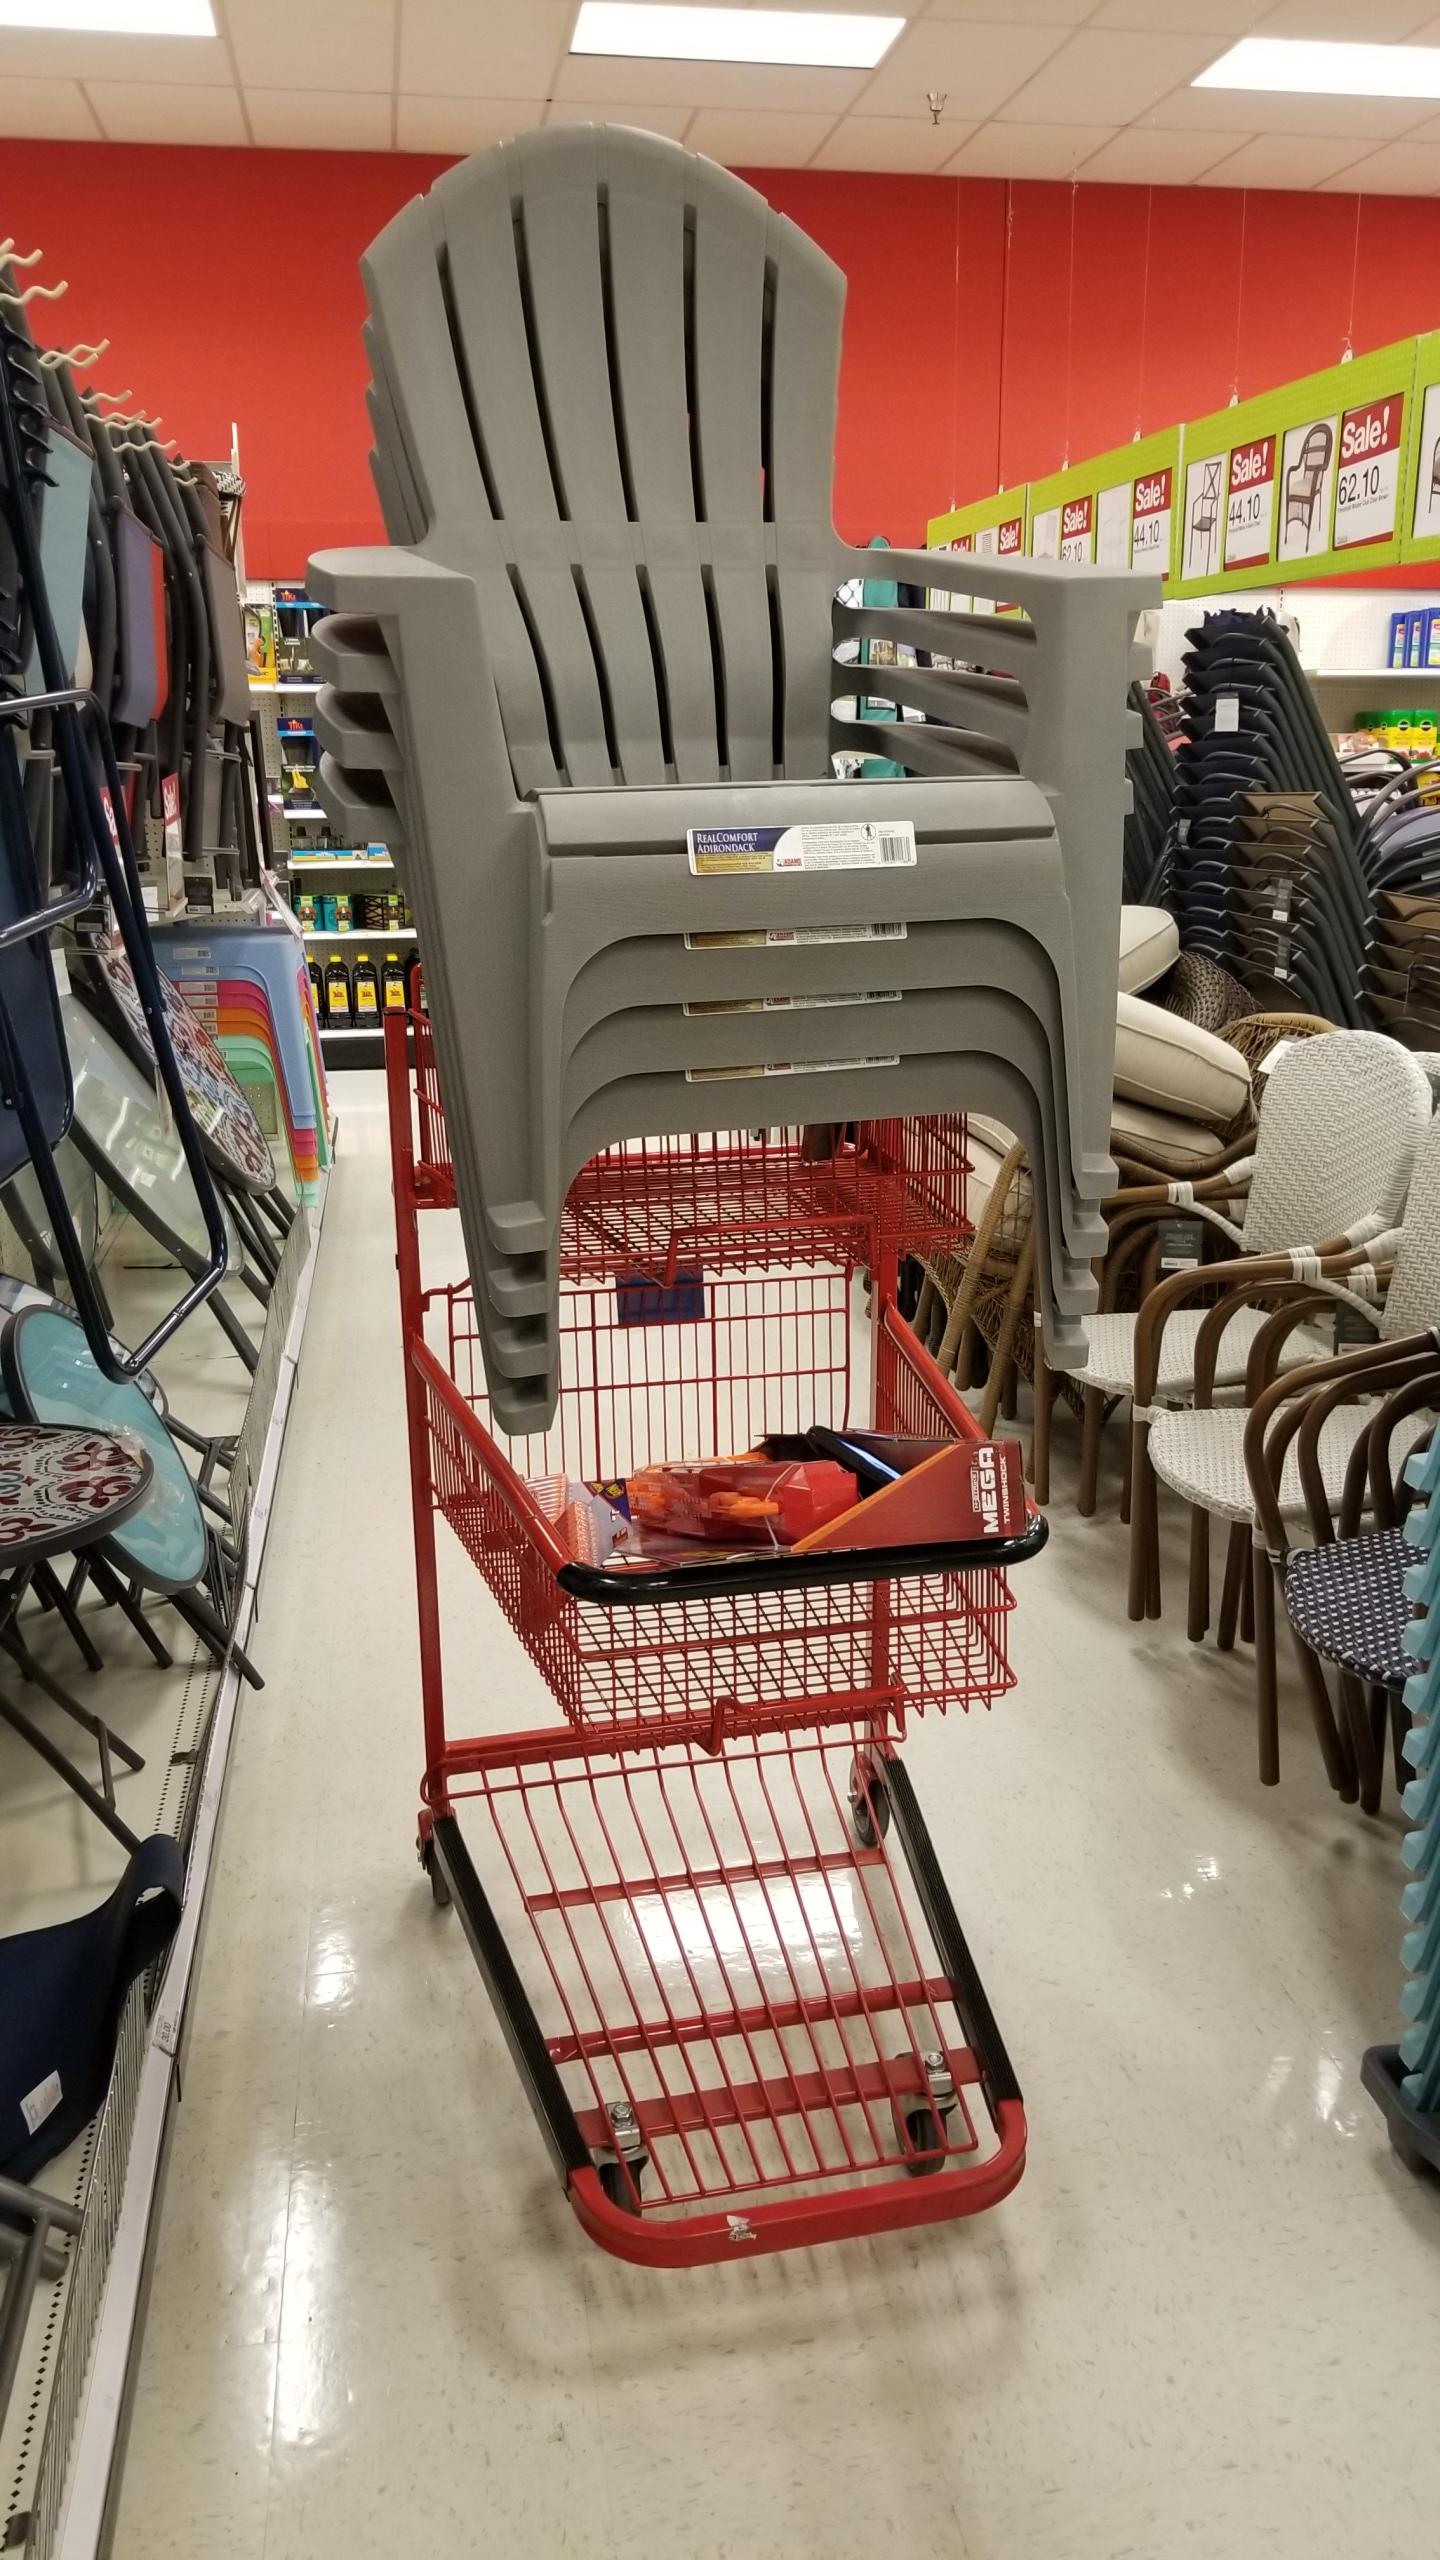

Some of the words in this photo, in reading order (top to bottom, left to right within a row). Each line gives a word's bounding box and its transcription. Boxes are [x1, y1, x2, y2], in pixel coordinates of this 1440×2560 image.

[1342, 406, 1390, 459] Sale!
[1231, 441, 1268, 486] Sale!
[1135, 474, 1166, 512] Sale!
[1339, 465, 1379, 505] 62.10
[1063, 501, 1088, 534] Sale!
[1229, 493, 1260, 526] 44.10
[1000, 522, 1020, 551] Sale!
[1134, 520, 1160, 546] 44.10
[697, 843, 756, 854] ADIRONDACK
[979, 1447, 999, 1533] MEGA
[999, 1453, 1011, 1524] TWINSHOCK
